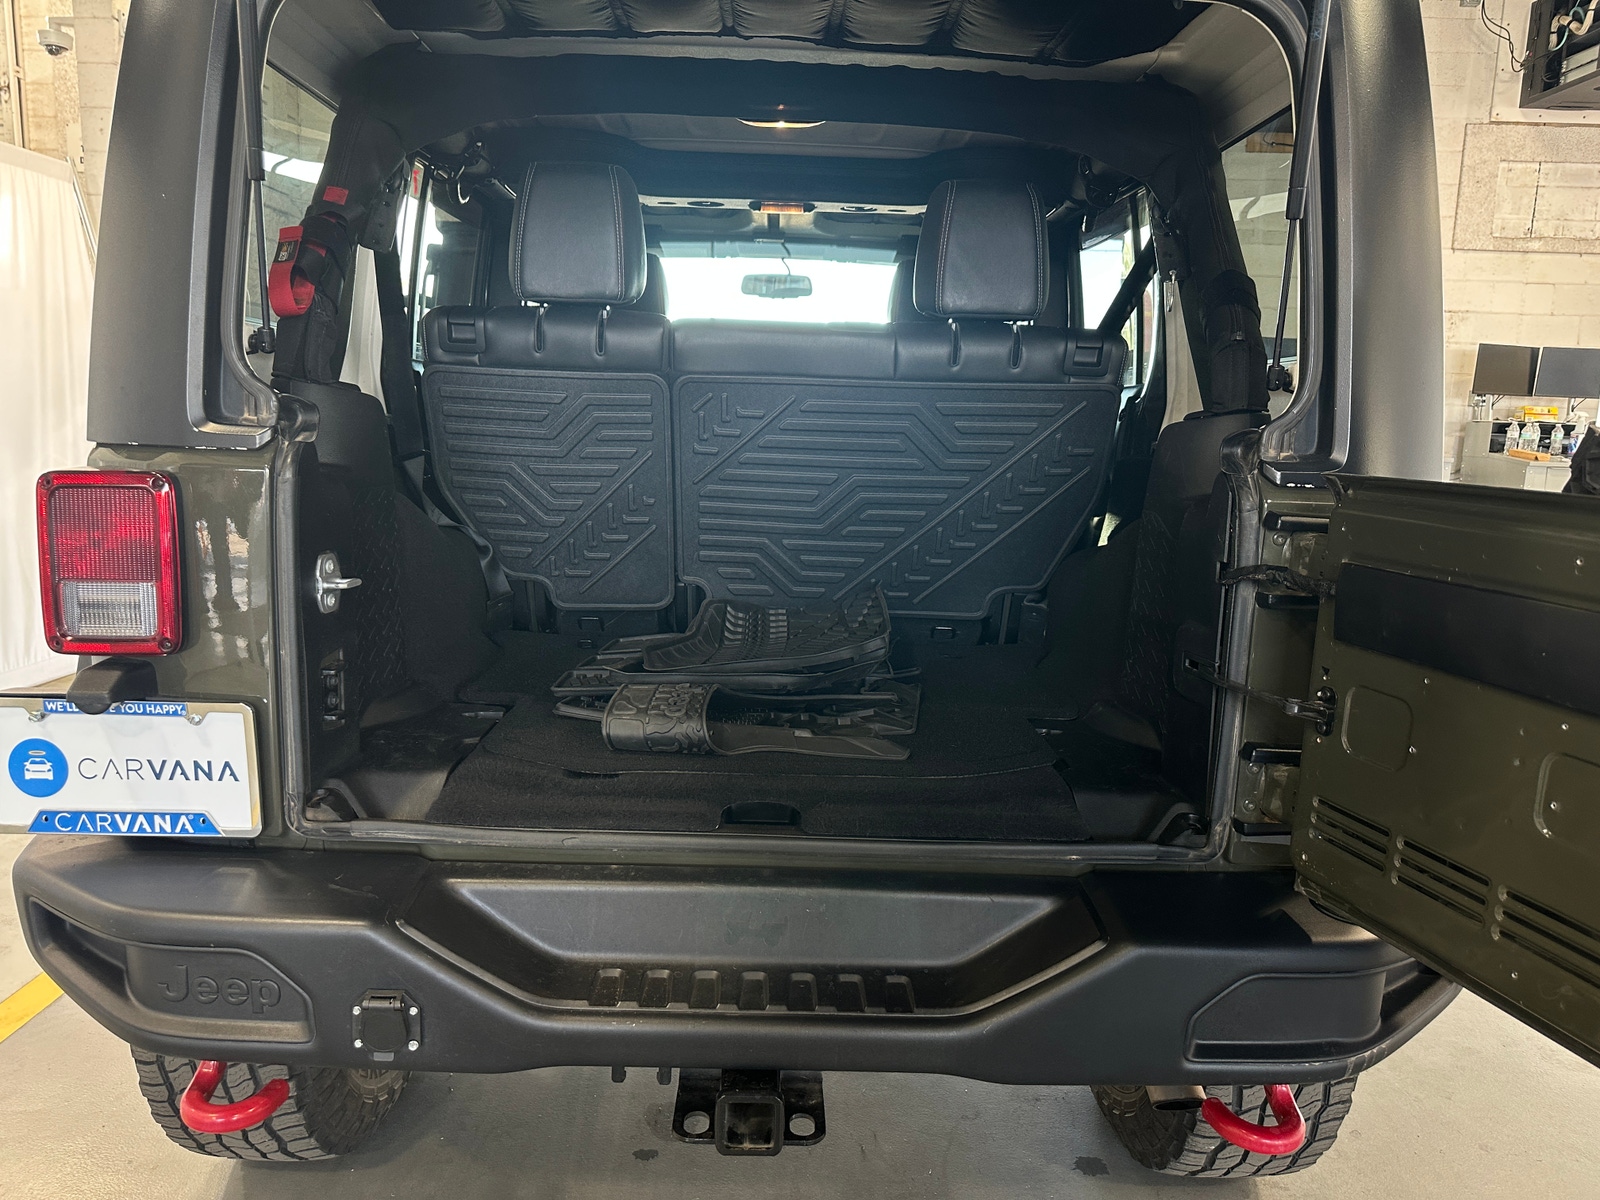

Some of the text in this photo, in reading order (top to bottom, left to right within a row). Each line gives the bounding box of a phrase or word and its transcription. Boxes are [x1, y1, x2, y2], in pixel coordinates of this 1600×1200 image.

[119, 703, 144, 713] YOU
[77, 757, 241, 782] CARVANA
[158, 964, 282, 1014] Jeep
